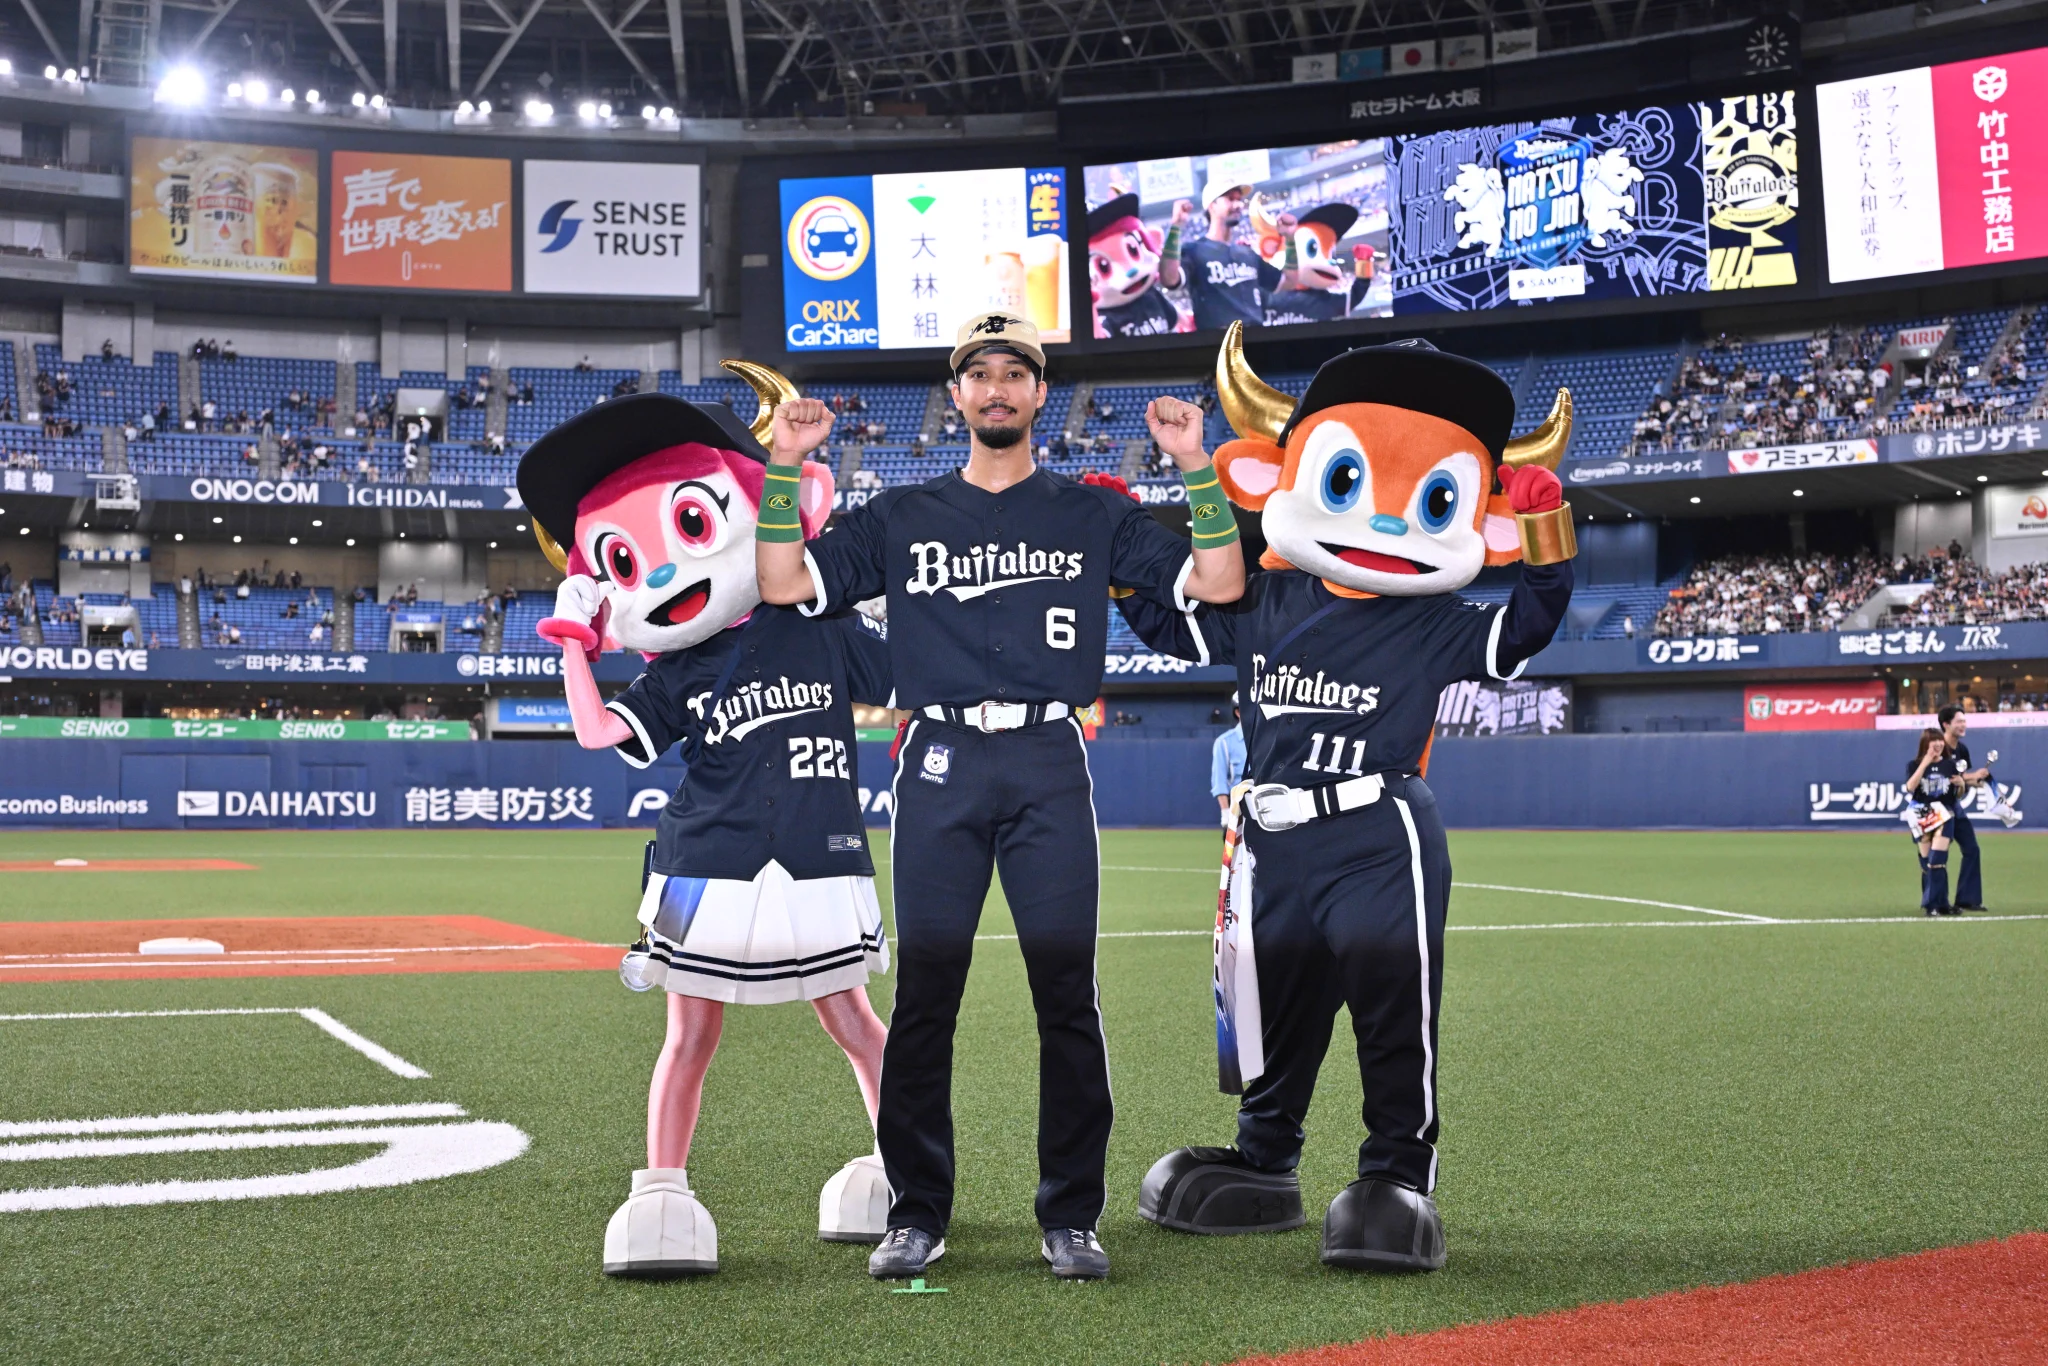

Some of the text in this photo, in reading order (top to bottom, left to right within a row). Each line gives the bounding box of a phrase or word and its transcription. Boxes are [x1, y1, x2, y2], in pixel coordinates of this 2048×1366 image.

[342, 168, 422, 220] 声で
[1507, 158, 1579, 208] NATSU
[1977, 109, 2014, 254] 竹中工務店
[169, 173, 191, 247] 一番搾り
[593, 201, 686, 226] SENSE
[1029, 184, 1061, 222] 生
[1509, 192, 1580, 241] NO JIN
[594, 231, 684, 257] TRUST
[910, 232, 939, 338] 大林組
[802, 299, 861, 323] ORIX
[787, 322, 878, 347] CarShare
[1937, 424, 2042, 456] ホシザキ
[190, 478, 320, 504] ONOCOM
[905, 541, 1084, 600] Buffaloes
[1046, 606, 1076, 650] 6
[95, 649, 148, 671] EYE
[61, 720, 129, 737] SENKO
[171, 721, 238, 738] センコー
[279, 722, 345, 739] SENKO
[385, 722, 449, 739] センコー
[788, 737, 851, 780] 222
[1302, 732, 1367, 777] 111
[60, 795, 149, 815] Business
[225, 790, 376, 817] DAIHATSU
[405, 787, 594, 822] 能美防災
